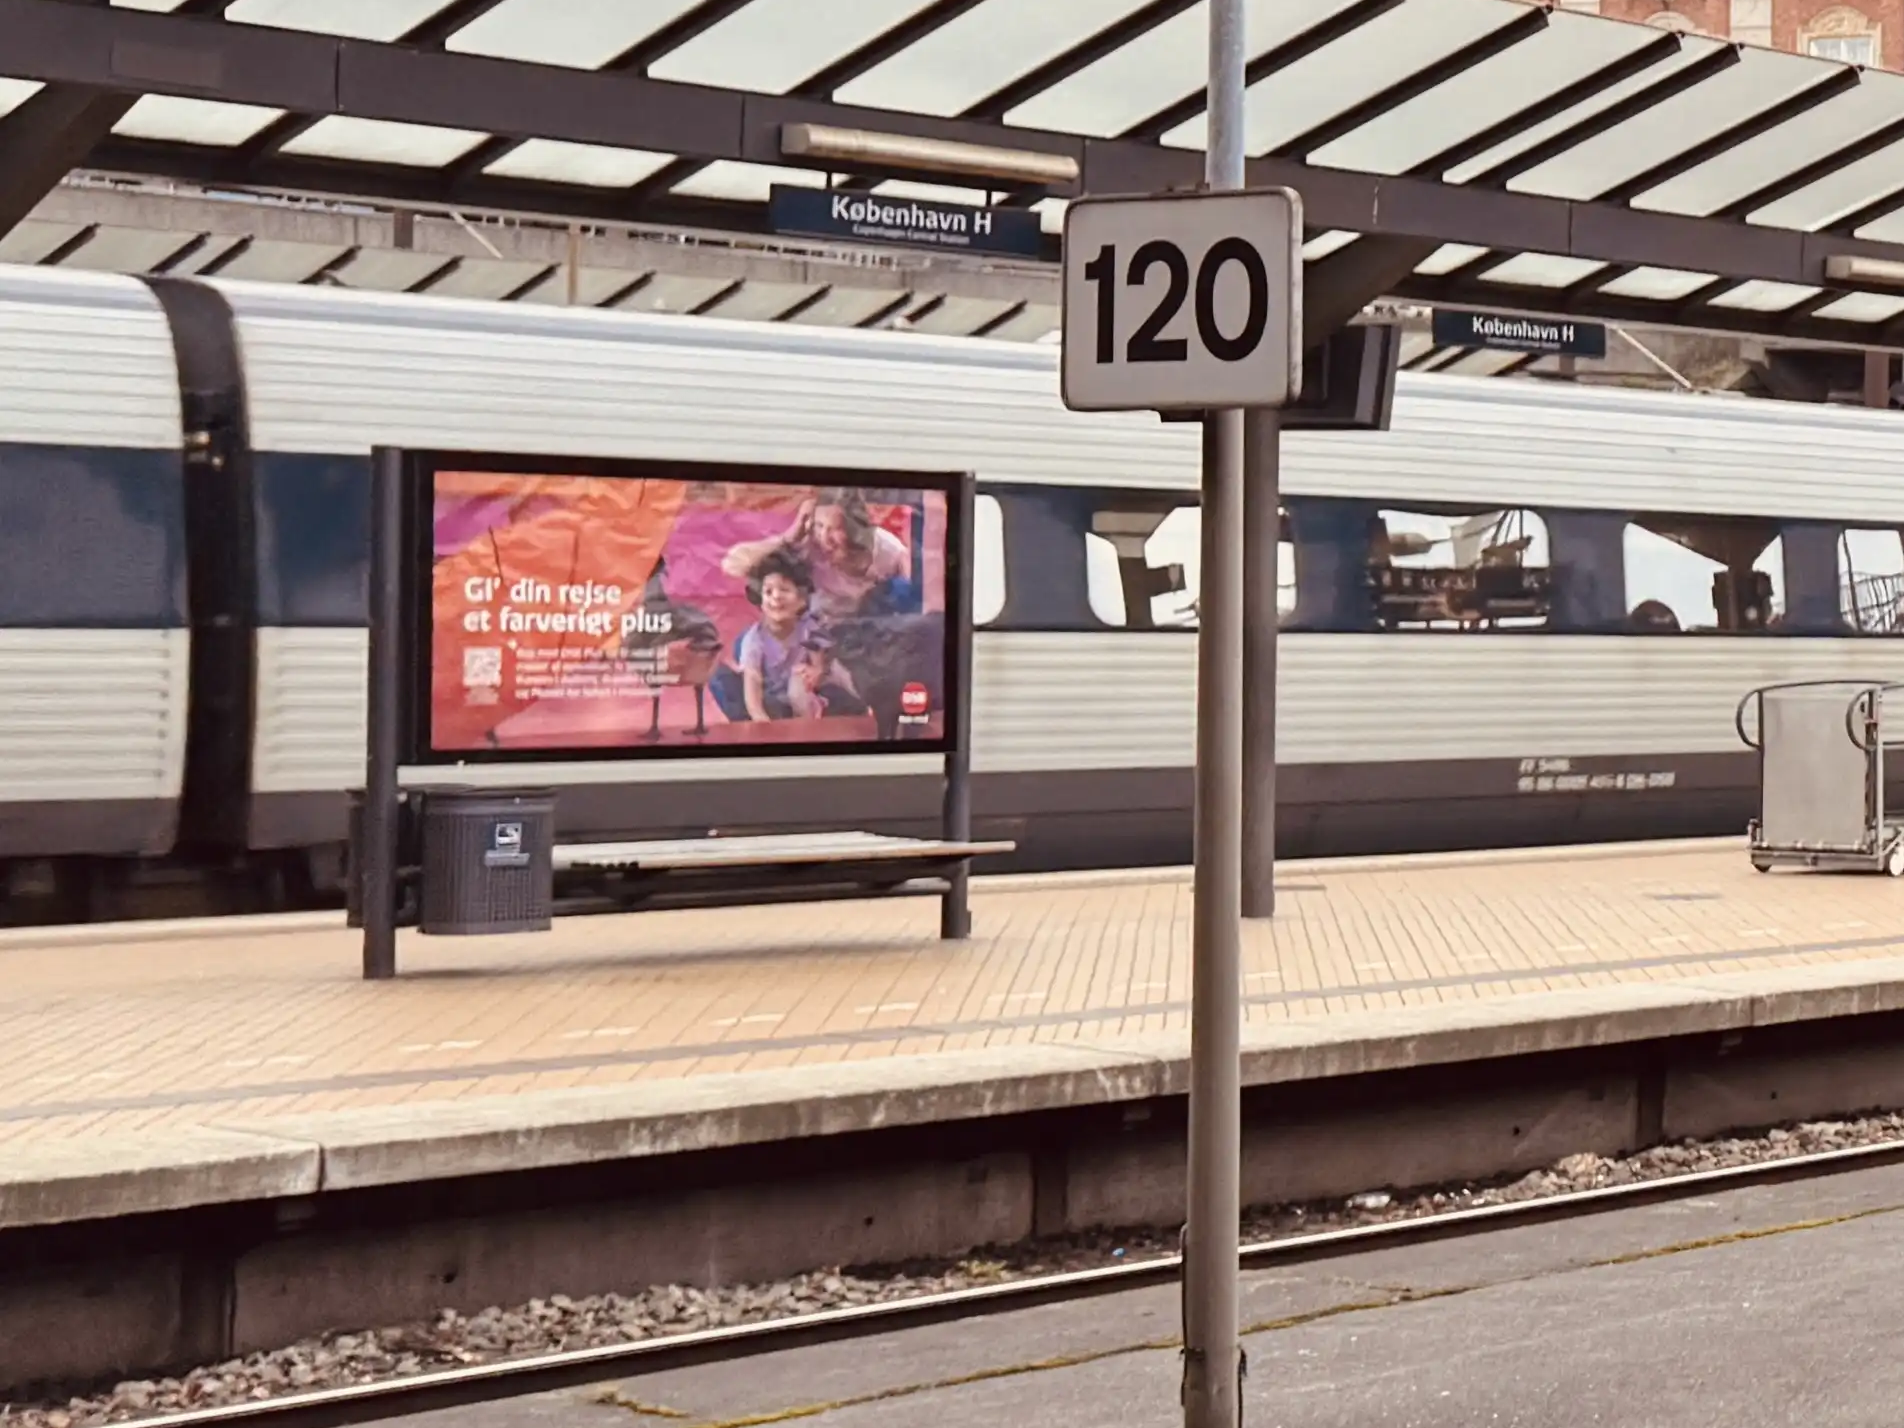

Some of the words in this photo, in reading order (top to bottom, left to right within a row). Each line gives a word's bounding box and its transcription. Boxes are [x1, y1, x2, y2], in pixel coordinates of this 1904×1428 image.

[831, 194, 967, 232] København
[973, 211, 992, 236] H
[1084, 236, 1269, 364] 120
[1562, 324, 1575, 343] H
[510, 577, 551, 604] din
[558, 579, 622, 609] rejse
[463, 609, 492, 633] et
[499, 606, 613, 636] farverigt
[621, 606, 673, 638] plus
